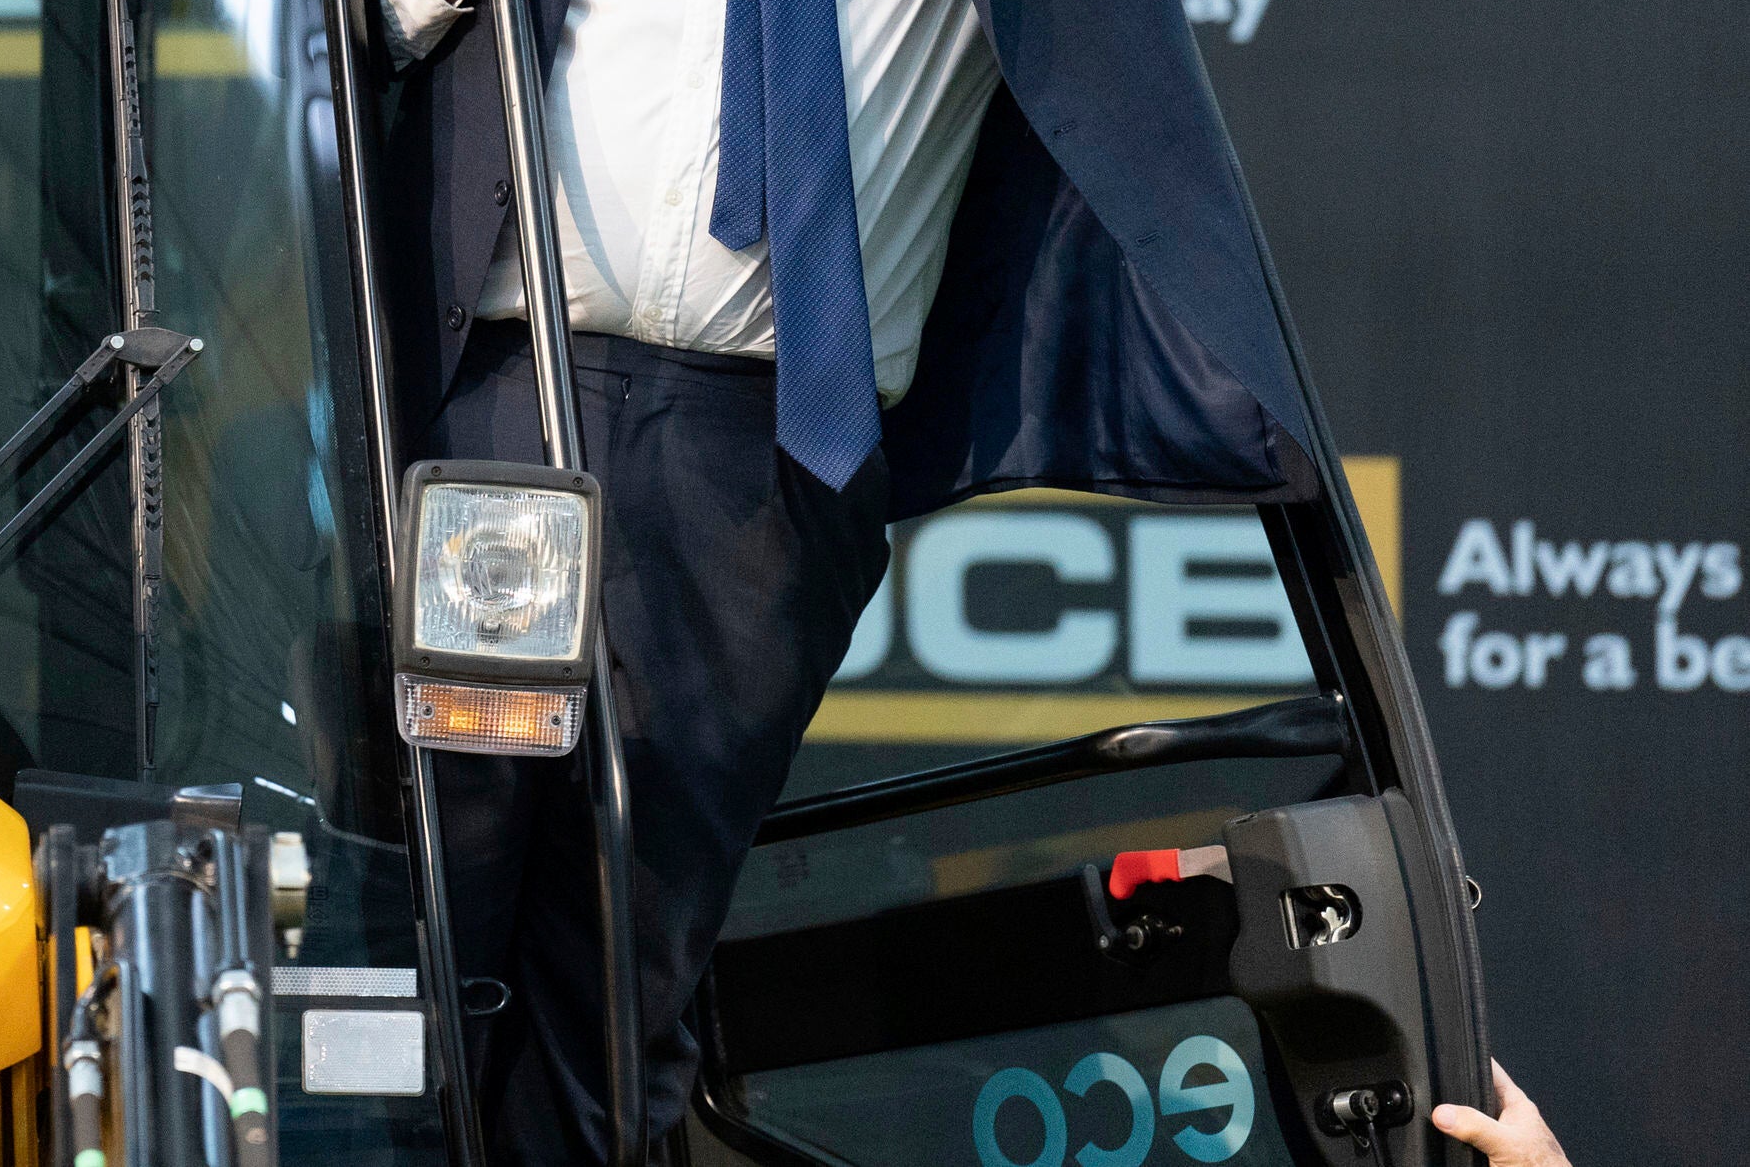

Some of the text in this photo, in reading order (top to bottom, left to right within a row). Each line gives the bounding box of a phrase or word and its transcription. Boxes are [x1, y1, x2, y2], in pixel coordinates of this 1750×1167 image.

[1439, 519, 1741, 611] Always
[1440, 611, 1750, 691] for a be
